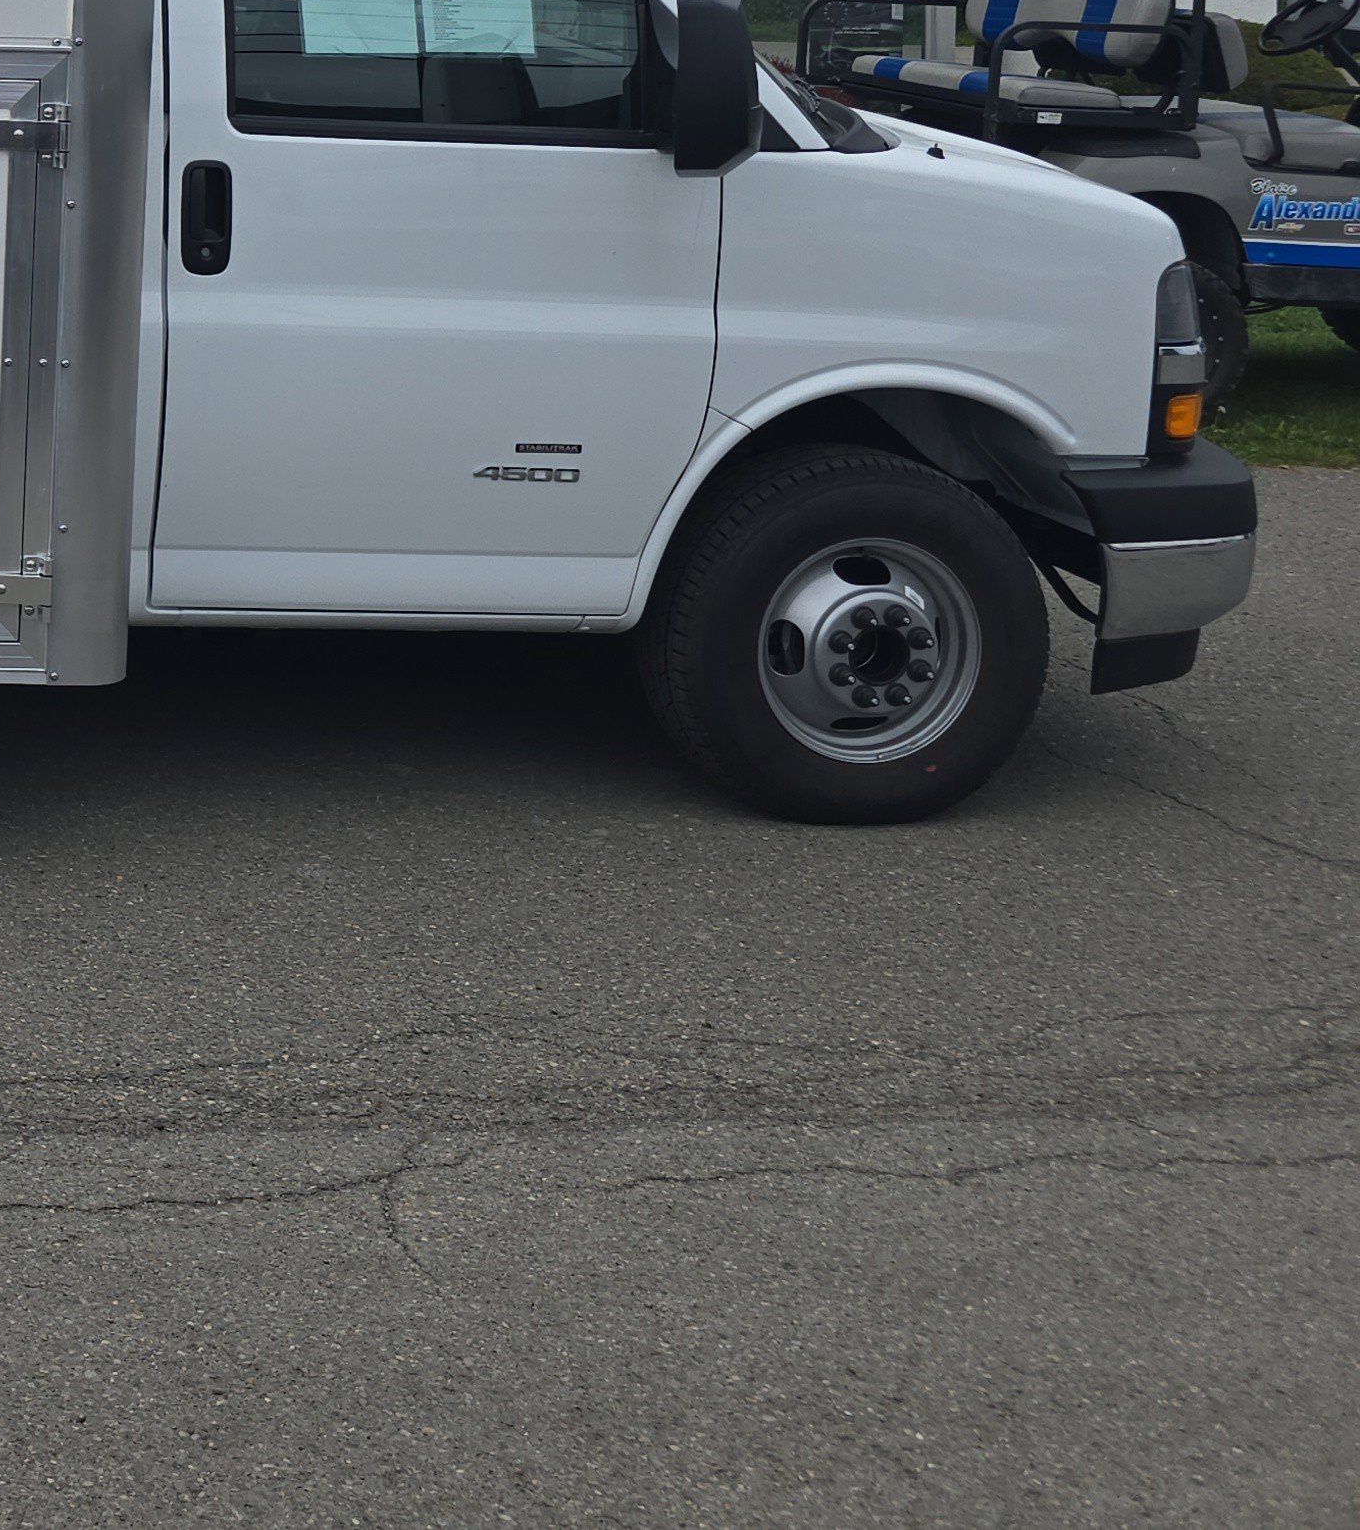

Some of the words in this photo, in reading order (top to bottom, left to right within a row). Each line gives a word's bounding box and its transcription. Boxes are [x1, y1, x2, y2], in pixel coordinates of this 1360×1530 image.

[1247, 193, 1360, 231] Alexand
[518, 444, 579, 453] STABILITRAK
[473, 466, 581, 483] 4500
